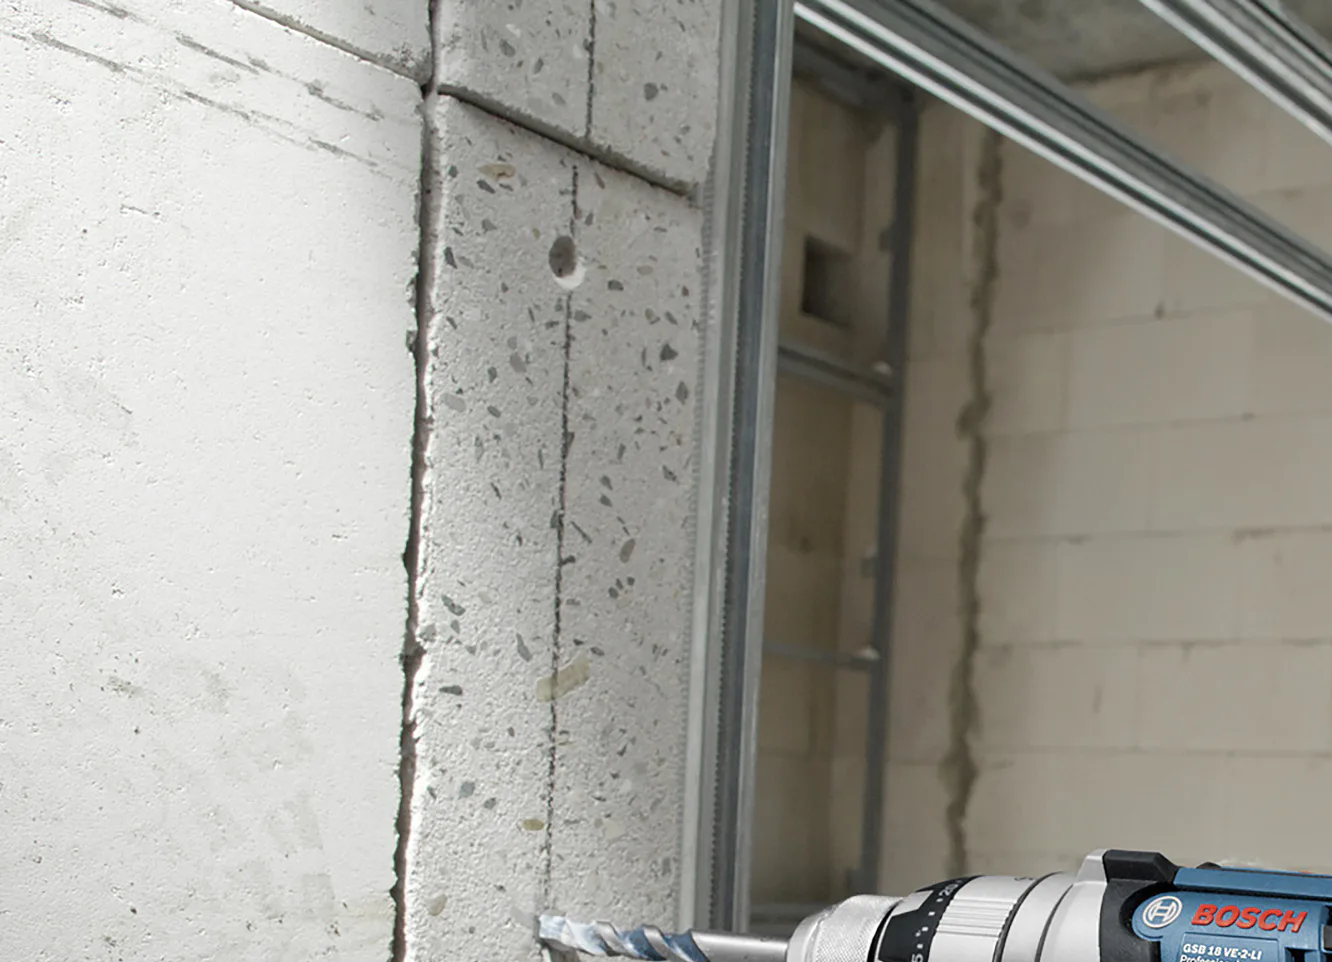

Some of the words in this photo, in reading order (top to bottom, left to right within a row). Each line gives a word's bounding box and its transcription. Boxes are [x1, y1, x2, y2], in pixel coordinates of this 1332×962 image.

[1191, 904, 1308, 933] BOSCH
[1182, 943, 1206, 955] GSB
[1207, 945, 1222, 957] 18
